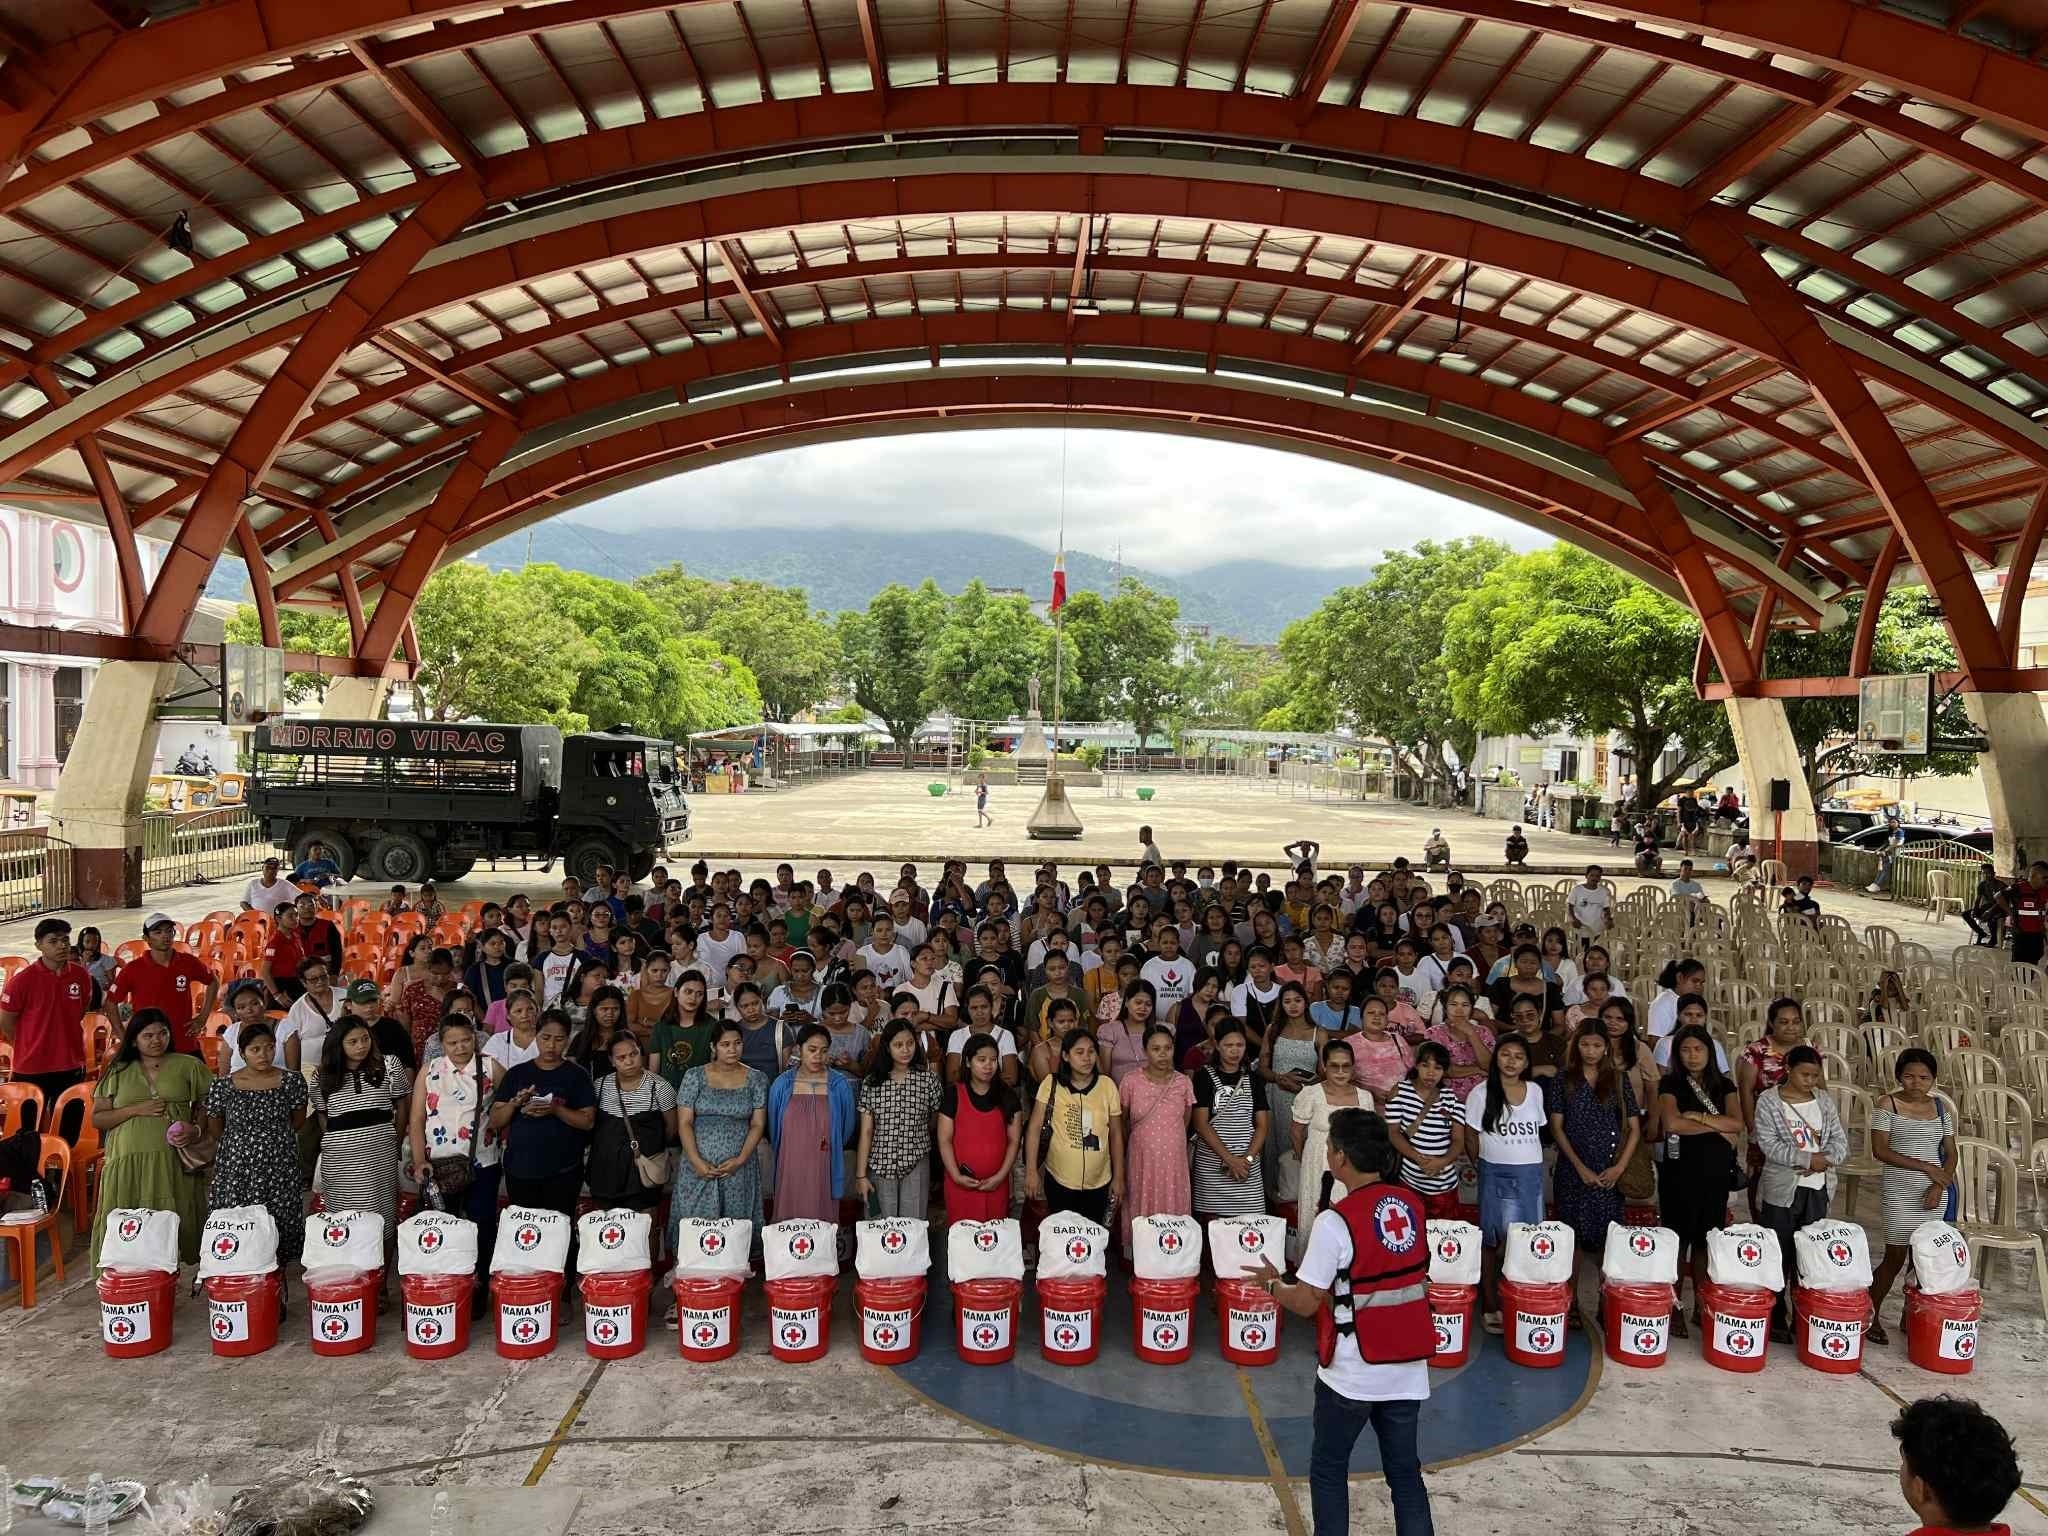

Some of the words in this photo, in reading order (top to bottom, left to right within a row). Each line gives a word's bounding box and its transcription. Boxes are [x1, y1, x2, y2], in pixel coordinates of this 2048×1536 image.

[270, 726, 396, 750] MDRRMO
[411, 729, 505, 753] VIRAC
[346, 1211, 362, 1223] KIT
[540, 1214, 559, 1224] KIT
[620, 1211, 637, 1221] KIT
[205, 1221, 232, 1230] BABY
[236, 1222, 255, 1231] KIT
[1053, 1226, 1083, 1235] BABY
[1086, 1226, 1101, 1236] KIT
[1451, 1225, 1468, 1234] KIT
[1932, 1232, 1954, 1248] BABY
[127, 1302, 147, 1315] KIT
[226, 1302, 246, 1314] KIT
[312, 1301, 339, 1314] MAMA
[342, 1301, 361, 1313] KIT
[407, 1305, 433, 1317] MAMA
[436, 1304, 455, 1317] KIT
[502, 1306, 531, 1316] MAMA
[534, 1303, 551, 1314] KIT
[612, 1306, 630, 1317] KIT
[682, 1309, 710, 1320] MAMA
[713, 1308, 728, 1320] KIT
[772, 1309, 798, 1321] MAMA
[801, 1309, 817, 1320] KIT
[864, 1309, 891, 1322] MAMA
[894, 1310, 910, 1322] KIT
[963, 1309, 991, 1322] MAMA
[993, 1310, 1009, 1321] KIT
[1045, 1310, 1071, 1322] MAMA
[1074, 1312, 1089, 1322] KIT
[1143, 1310, 1171, 1322] MAMA
[1174, 1311, 1188, 1322] KIT
[1230, 1310, 1259, 1322] MAMA
[1261, 1311, 1275, 1322] KIT
[1447, 1315, 1462, 1325] KIT
[1517, 1312, 1547, 1326] MAMA
[1550, 1314, 1564, 1326] KIT
[1622, 1314, 1653, 1328] MAMA
[1656, 1316, 1669, 1327] KIT
[1716, 1313, 1747, 1329] MAMA
[1750, 1319, 1765, 1329] KIT
[1810, 1317, 1842, 1331] MAMA
[1845, 1322, 1861, 1332] KIT
[1944, 1320, 1974, 1332] MAMA
